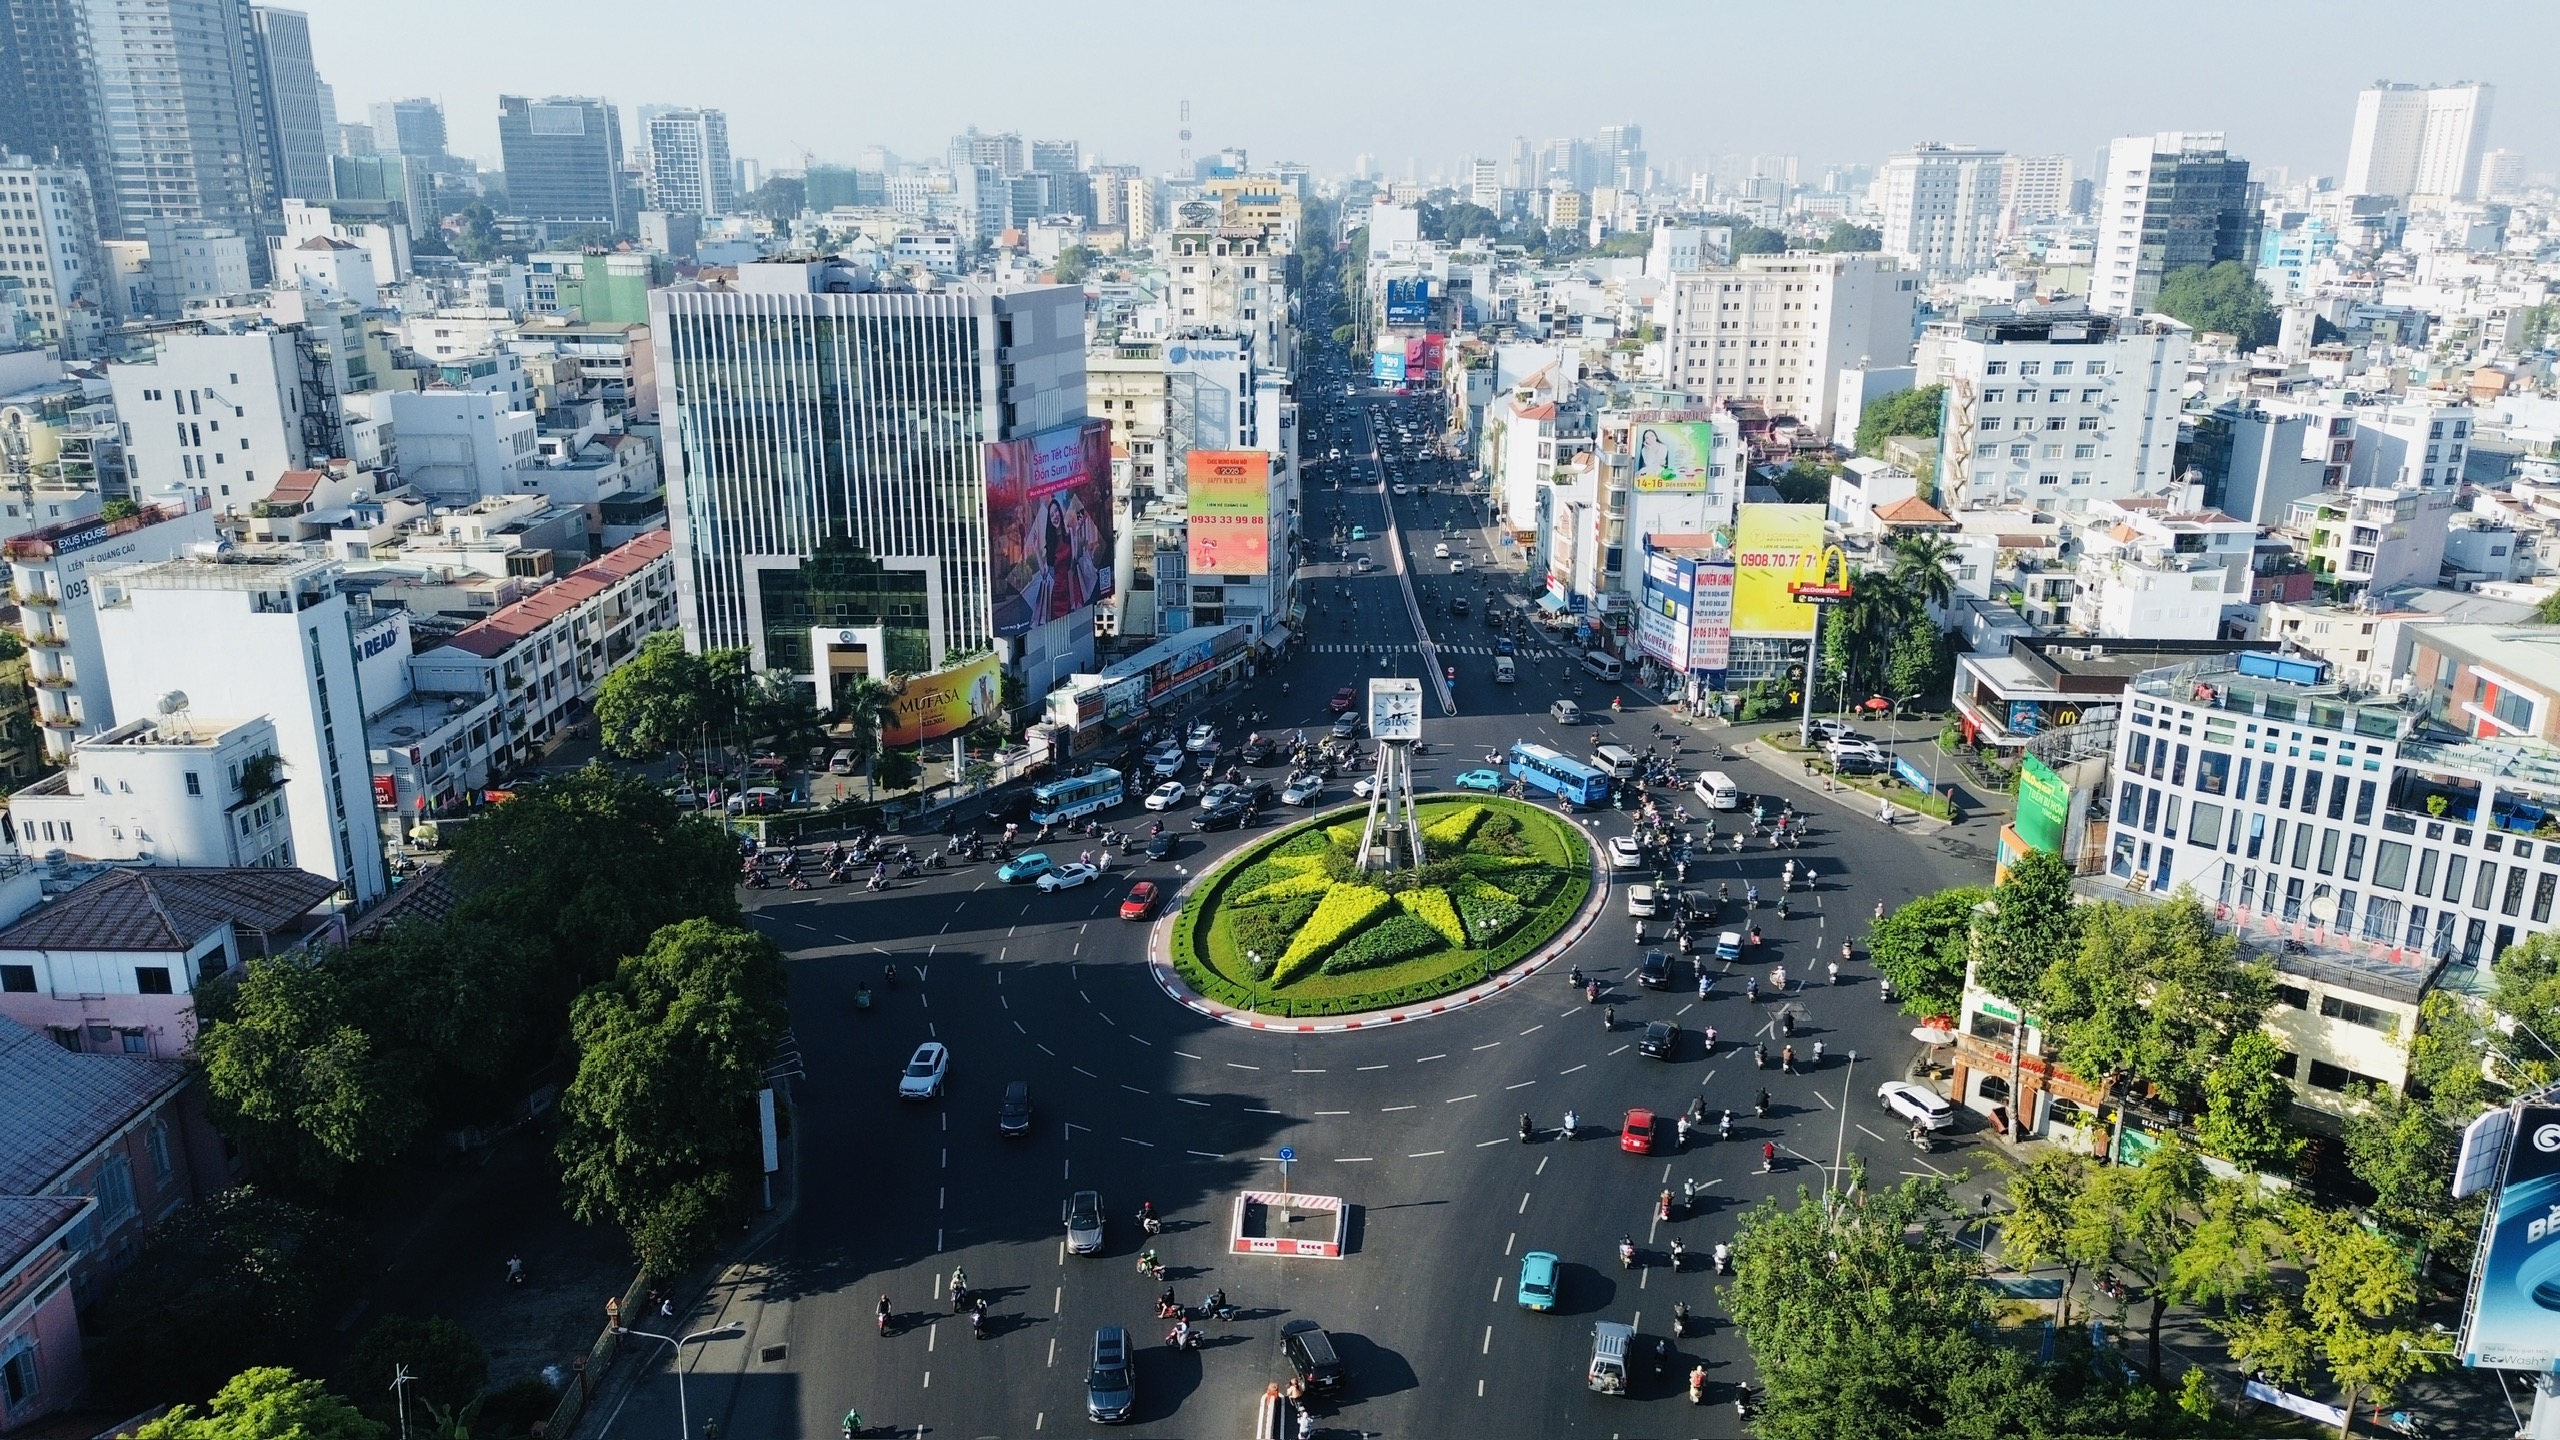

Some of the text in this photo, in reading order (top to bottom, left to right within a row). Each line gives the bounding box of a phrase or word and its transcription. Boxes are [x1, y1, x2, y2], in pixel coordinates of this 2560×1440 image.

[2205, 157, 2224, 165] TOWER
[1189, 350, 1237, 361] VNPT
[1051, 448, 1062, 460] Tết
[1051, 465, 1067, 477] Sum
[1636, 479, 1663, 488] 14-16
[1191, 515, 1264, 524] 0933 33 99 88
[81, 526, 107, 542] HOUSE
[67, 560, 84, 572] LIÊN
[364, 629, 396, 659] READ
[899, 688, 960, 715] MUFASA
[2482, 1353, 2547, 1366] EcoWash+
